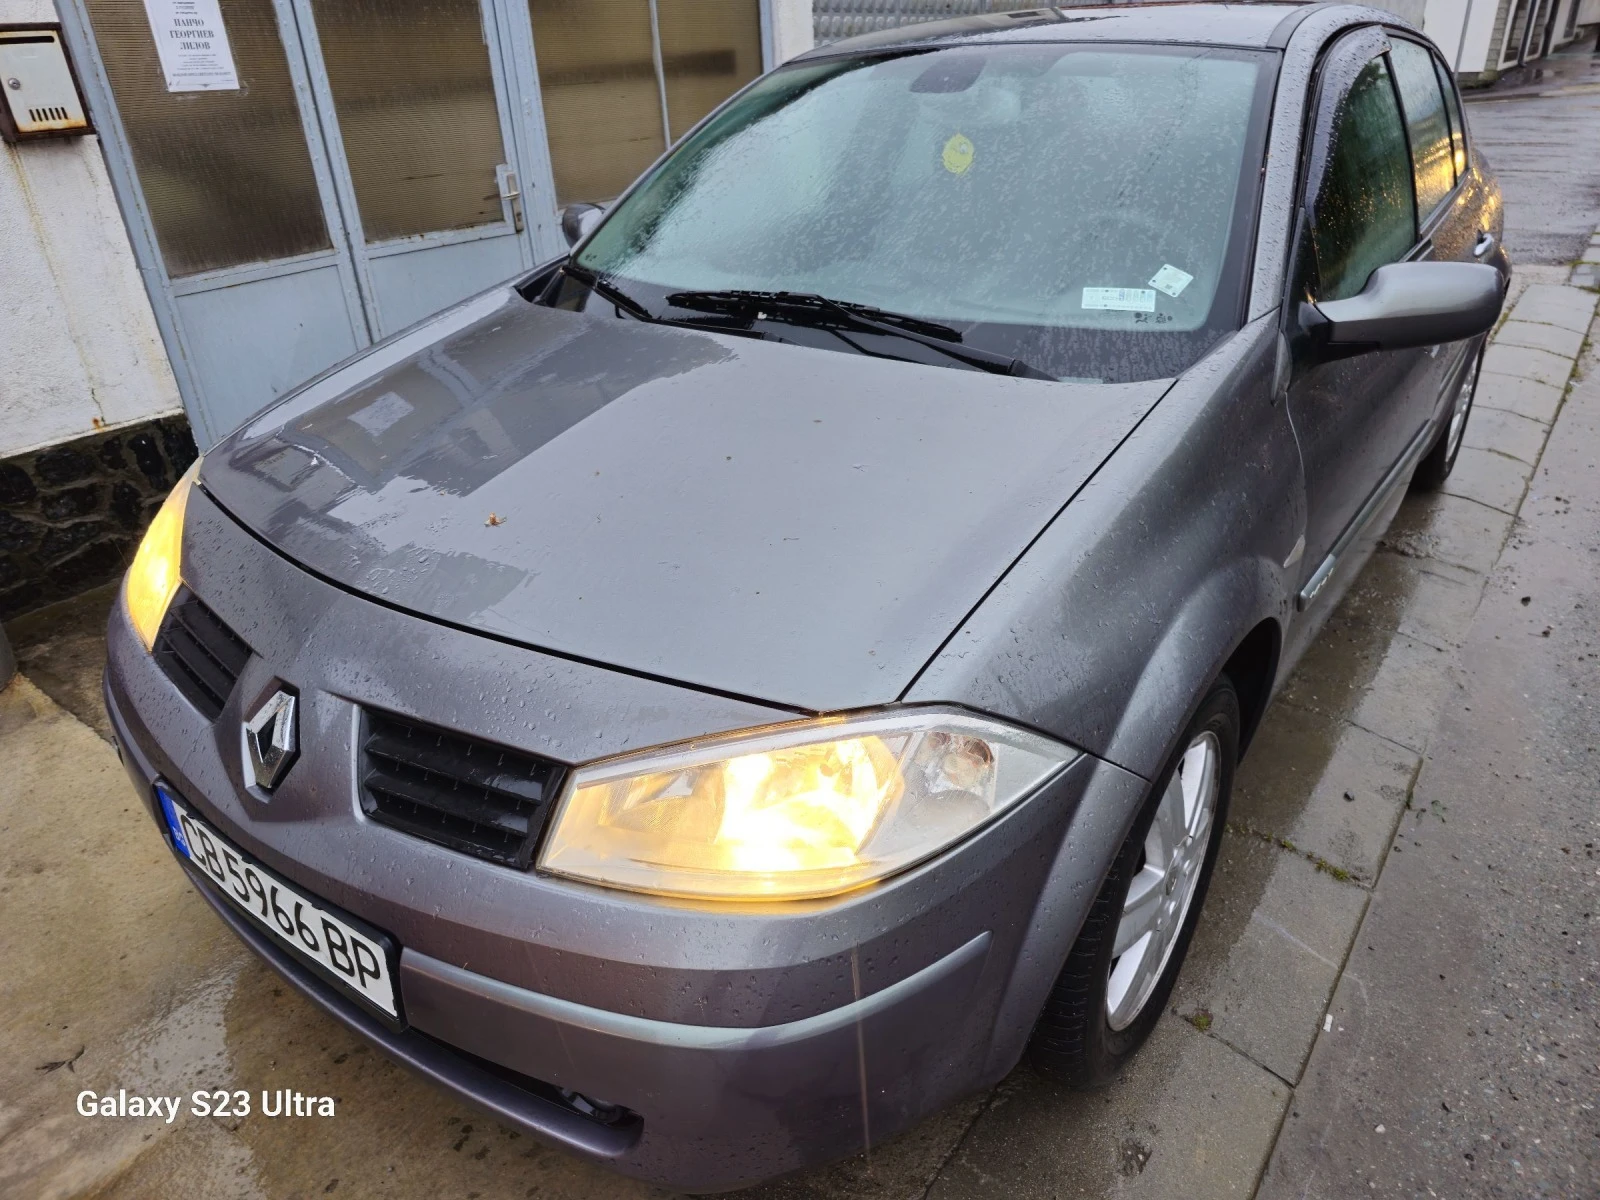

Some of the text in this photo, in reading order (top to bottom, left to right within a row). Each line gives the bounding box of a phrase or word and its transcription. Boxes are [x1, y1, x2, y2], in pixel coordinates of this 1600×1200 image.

[174, 18, 204, 26] ПАНЧО
[170, 30, 215, 39] ГЕОРГИЕВ
[180, 42, 211, 50] ЛИЛОВ
